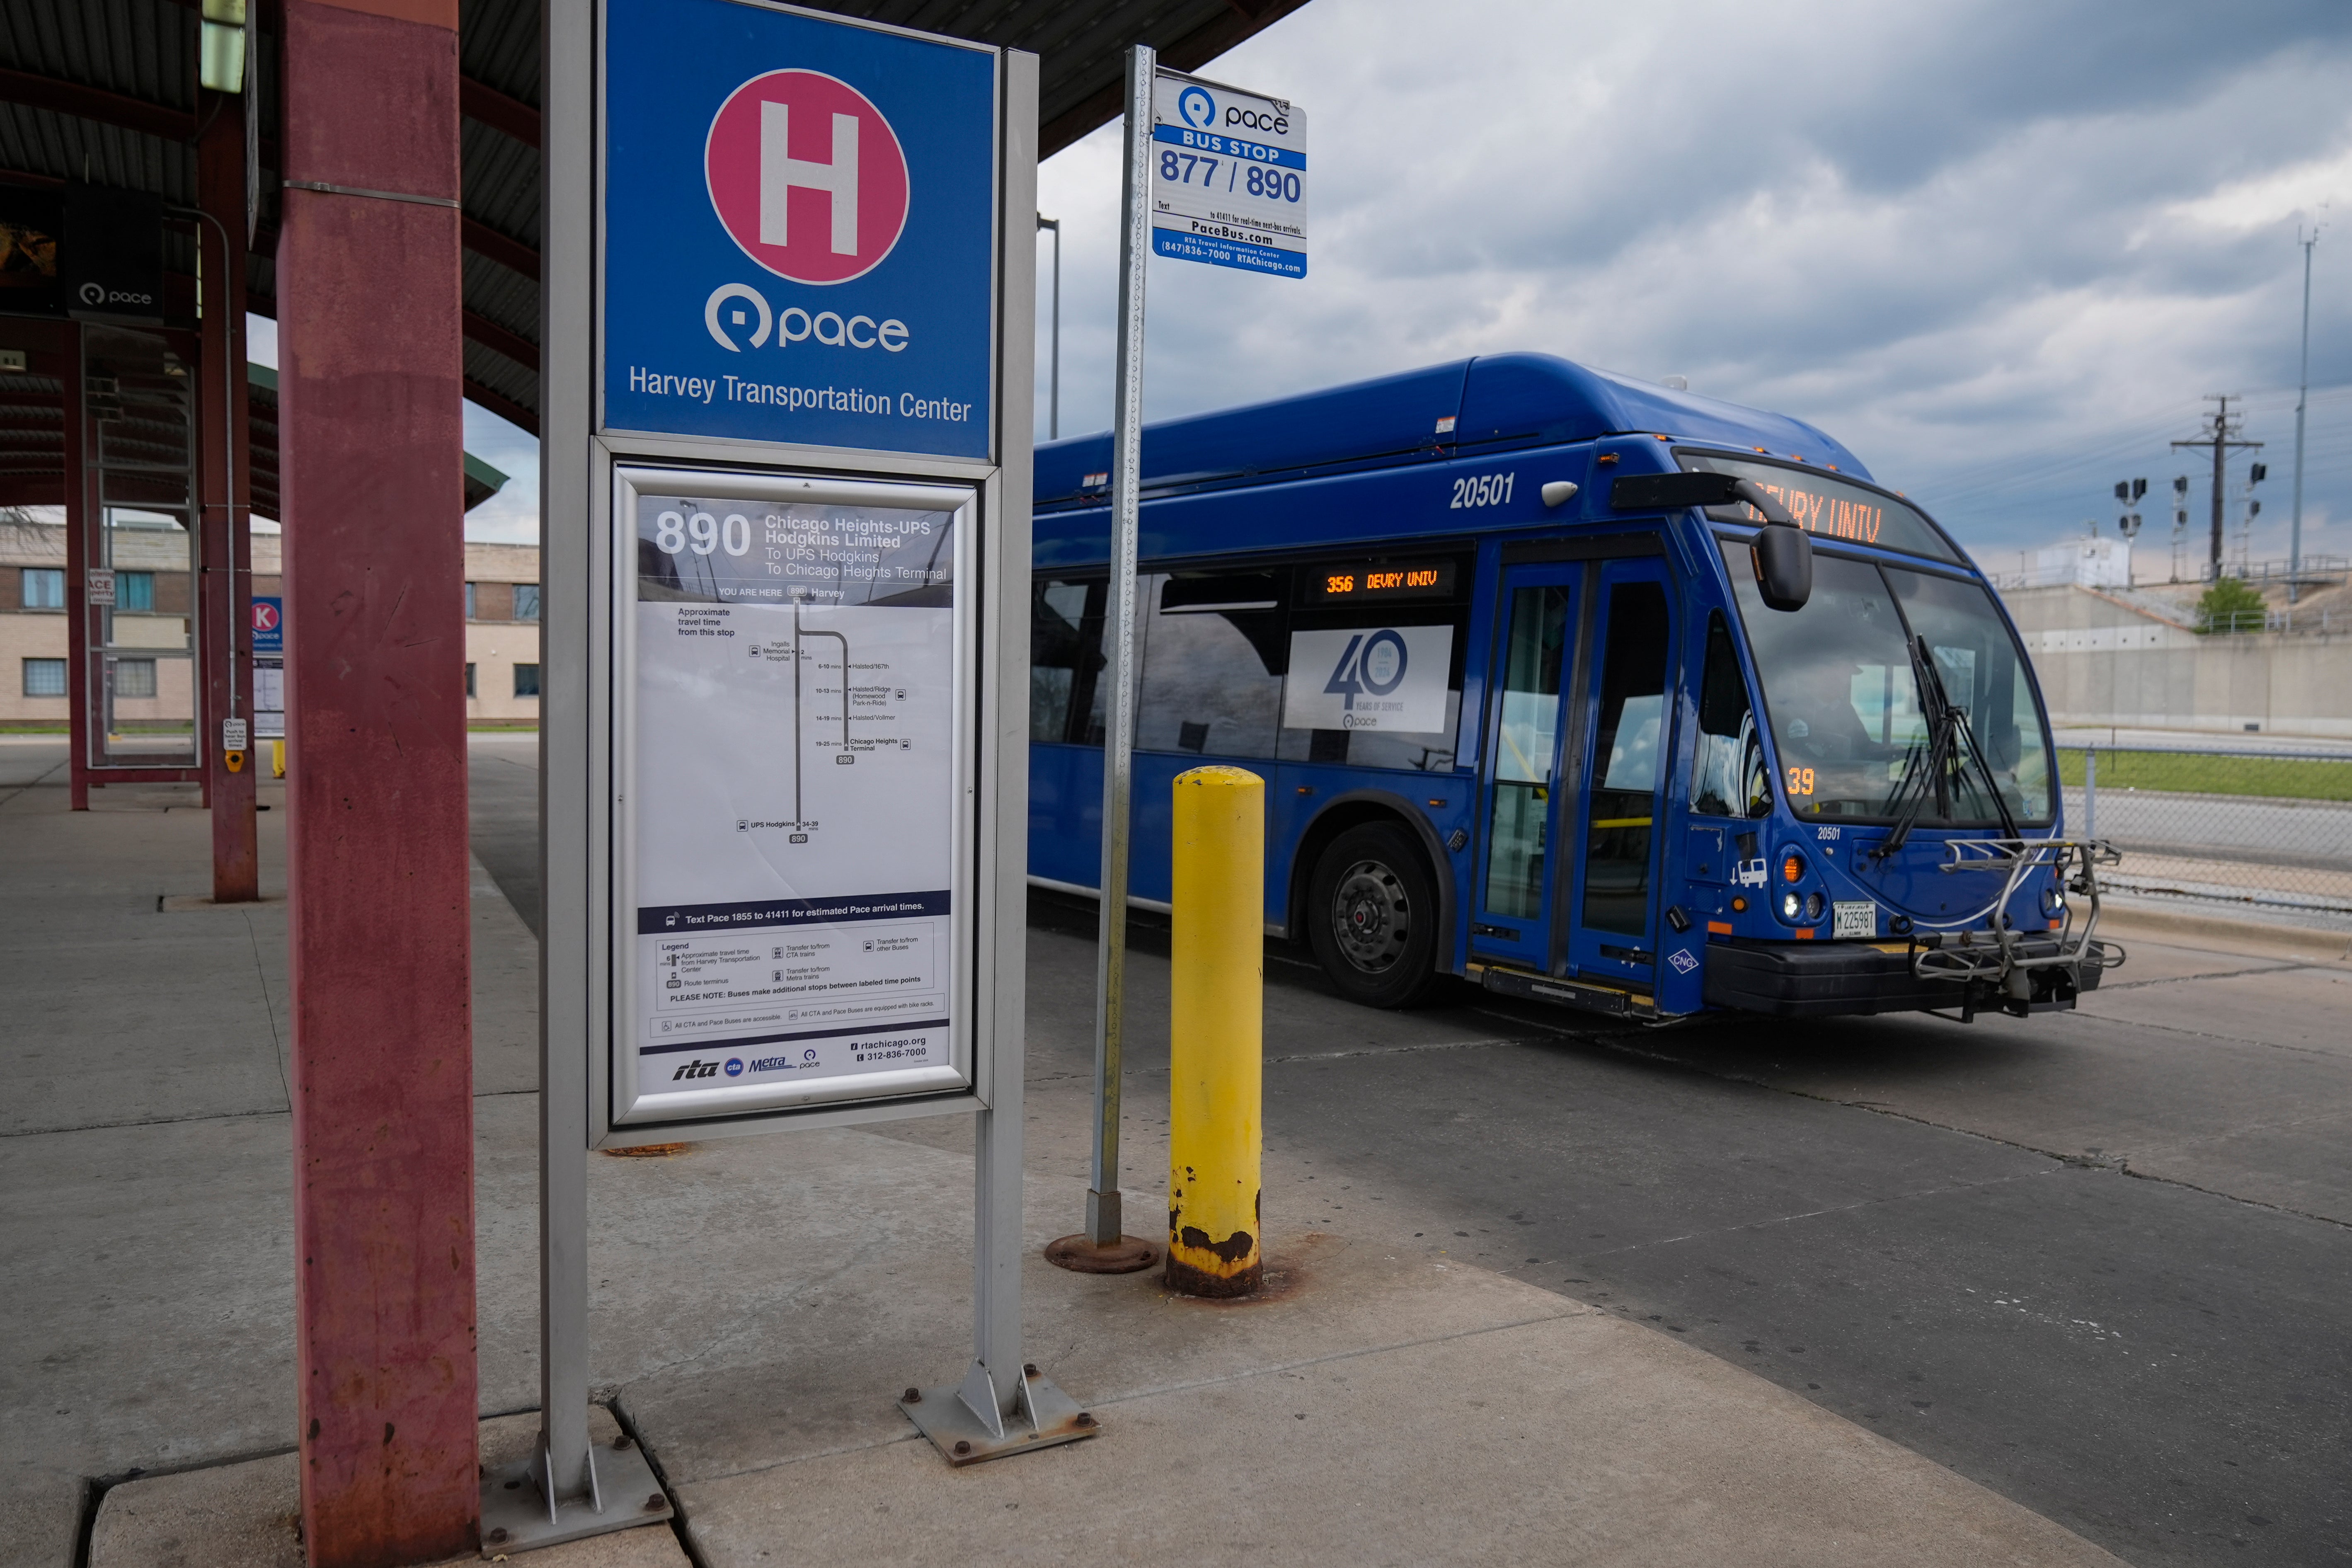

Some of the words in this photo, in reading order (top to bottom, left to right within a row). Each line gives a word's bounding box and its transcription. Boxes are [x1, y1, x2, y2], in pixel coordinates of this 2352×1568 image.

[1226, 107, 1288, 134] pace
[1184, 131, 1221, 150] BUS
[1230, 141, 1279, 162] STOP
[760, 100, 858, 256] H
[1161, 150, 1218, 187] 877
[1247, 166, 1300, 203] 890
[1159, 201, 1169, 210] Text
[1217, 212, 1230, 221] 41411
[1241, 217, 1261, 227] real-time
[1263, 222, 1281, 231] next-bus
[1192, 221, 1272, 245] PaceBus.com
[1199, 239, 1217, 247] Travel
[1221, 243, 1257, 254] Information
[1238, 250, 1300, 272] RTAChicago.com
[109, 291, 151, 304] pace
[779, 308, 909, 352] pace
[630, 366, 715, 404] Harvey
[723, 376, 890, 414] Transportation
[900, 393, 971, 422] Center
[1450, 472, 1514, 509] 20501
[656, 511, 751, 556] 890
[765, 515, 829, 533] Chicago
[836, 519, 930, 536] Heights-UPS
[766, 530, 839, 548] Hodgkins
[845, 533, 900, 548] Limited
[765, 548, 781, 559] To
[787, 548, 814, 560] UPS
[821, 549, 879, 565] Hodgkins
[765, 562, 781, 574] To
[786, 563, 838, 579] Chicago
[844, 565, 891, 580] Heights
[895, 567, 946, 579] Terminal
[1327, 576, 1354, 592] 356
[1367, 572, 1403, 589] DEVRY
[1407, 570, 1437, 586] UNIV
[812, 588, 845, 599] Harvey
[256, 608, 271, 627] K
[1324, 629, 1407, 710] 40
[1356, 702, 1371, 710] YEARS
[1382, 702, 1403, 711] SERVICE
[1354, 718, 1376, 727] pace
[1788, 768, 1814, 795] 39
[1818, 827, 1840, 840] 20501
[765, 910, 788, 919] 41411
[807, 907, 847, 916] estimated
[872, 904, 897, 912] arrival
[1845, 911, 1873, 929] 225987
[662, 943, 688, 951] Legend
[1674, 955, 1693, 967] CNG
[773, 984, 806, 994] additional
[862, 1038, 925, 1049] rtachicago.org
[868, 1048, 925, 1060] 312-836-7000
[673, 1060, 719, 1081] rta
[749, 1057, 785, 1072] Metra
